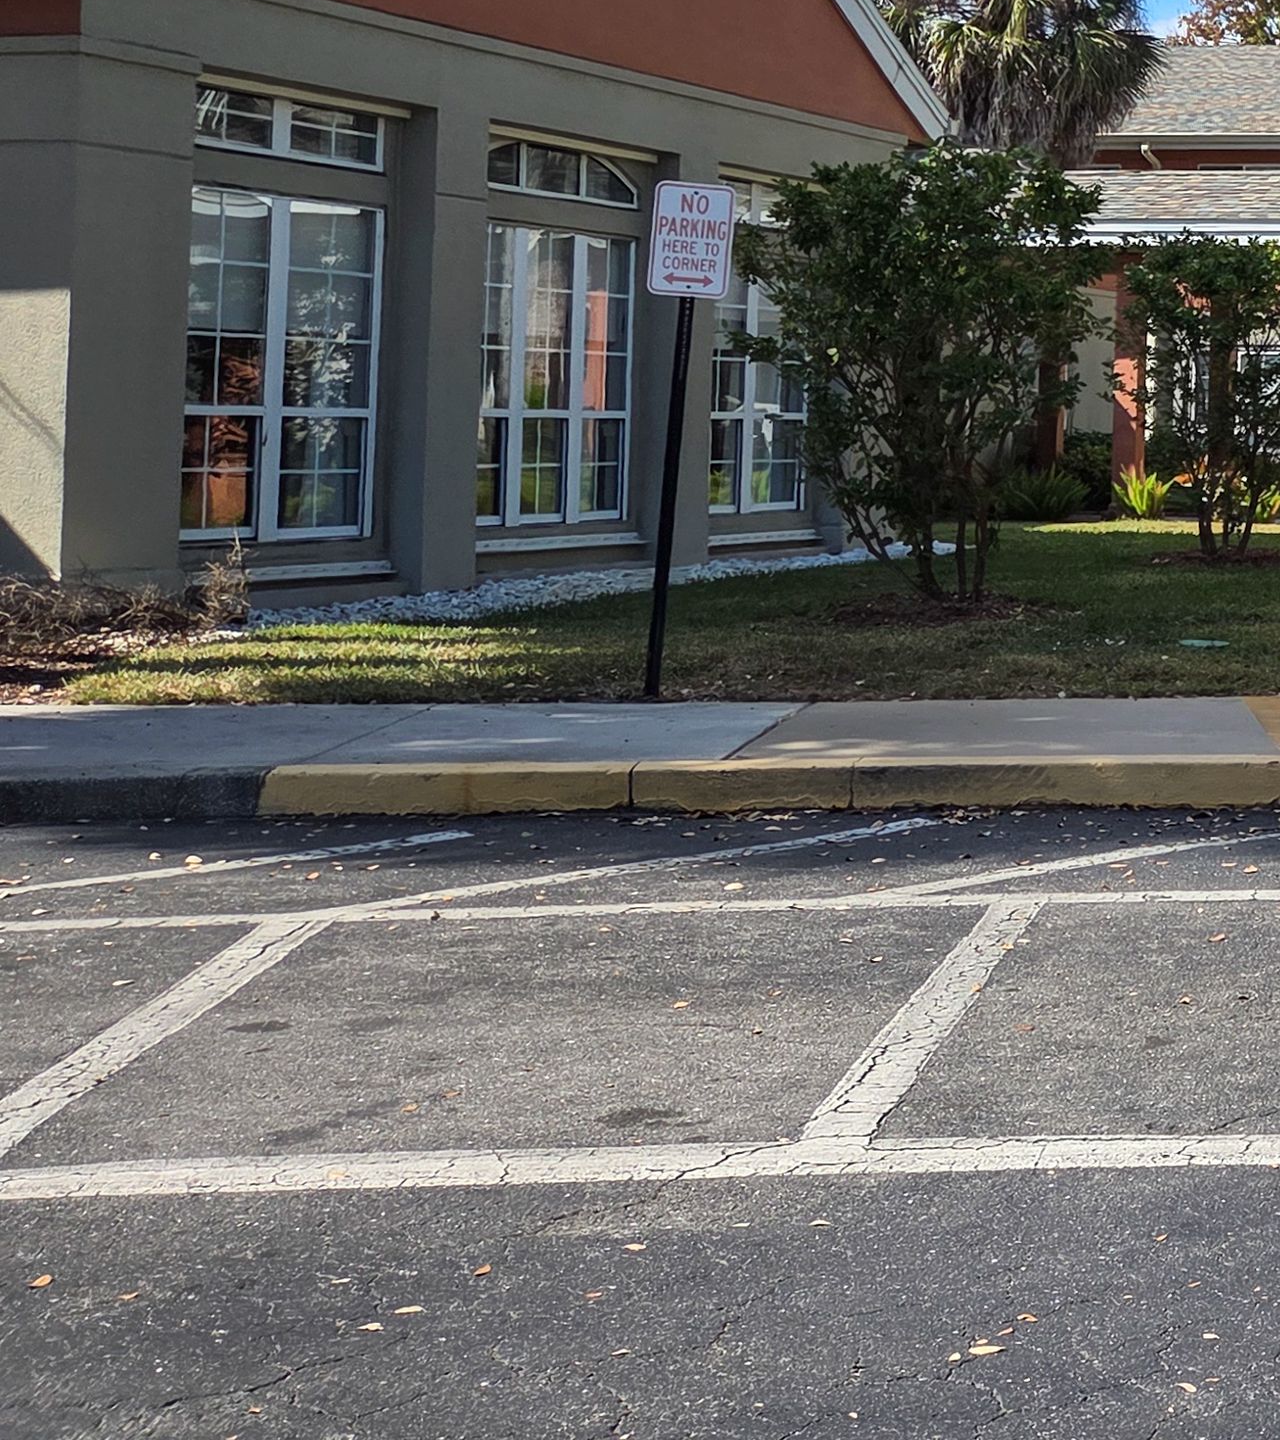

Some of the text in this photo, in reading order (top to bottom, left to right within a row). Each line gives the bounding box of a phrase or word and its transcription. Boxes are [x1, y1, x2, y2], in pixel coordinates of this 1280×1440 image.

[681, 193, 710, 215] NO
[658, 216, 727, 241] PARKING
[662, 238, 720, 257] HERE TO
[662, 256, 717, 273] CORNER
